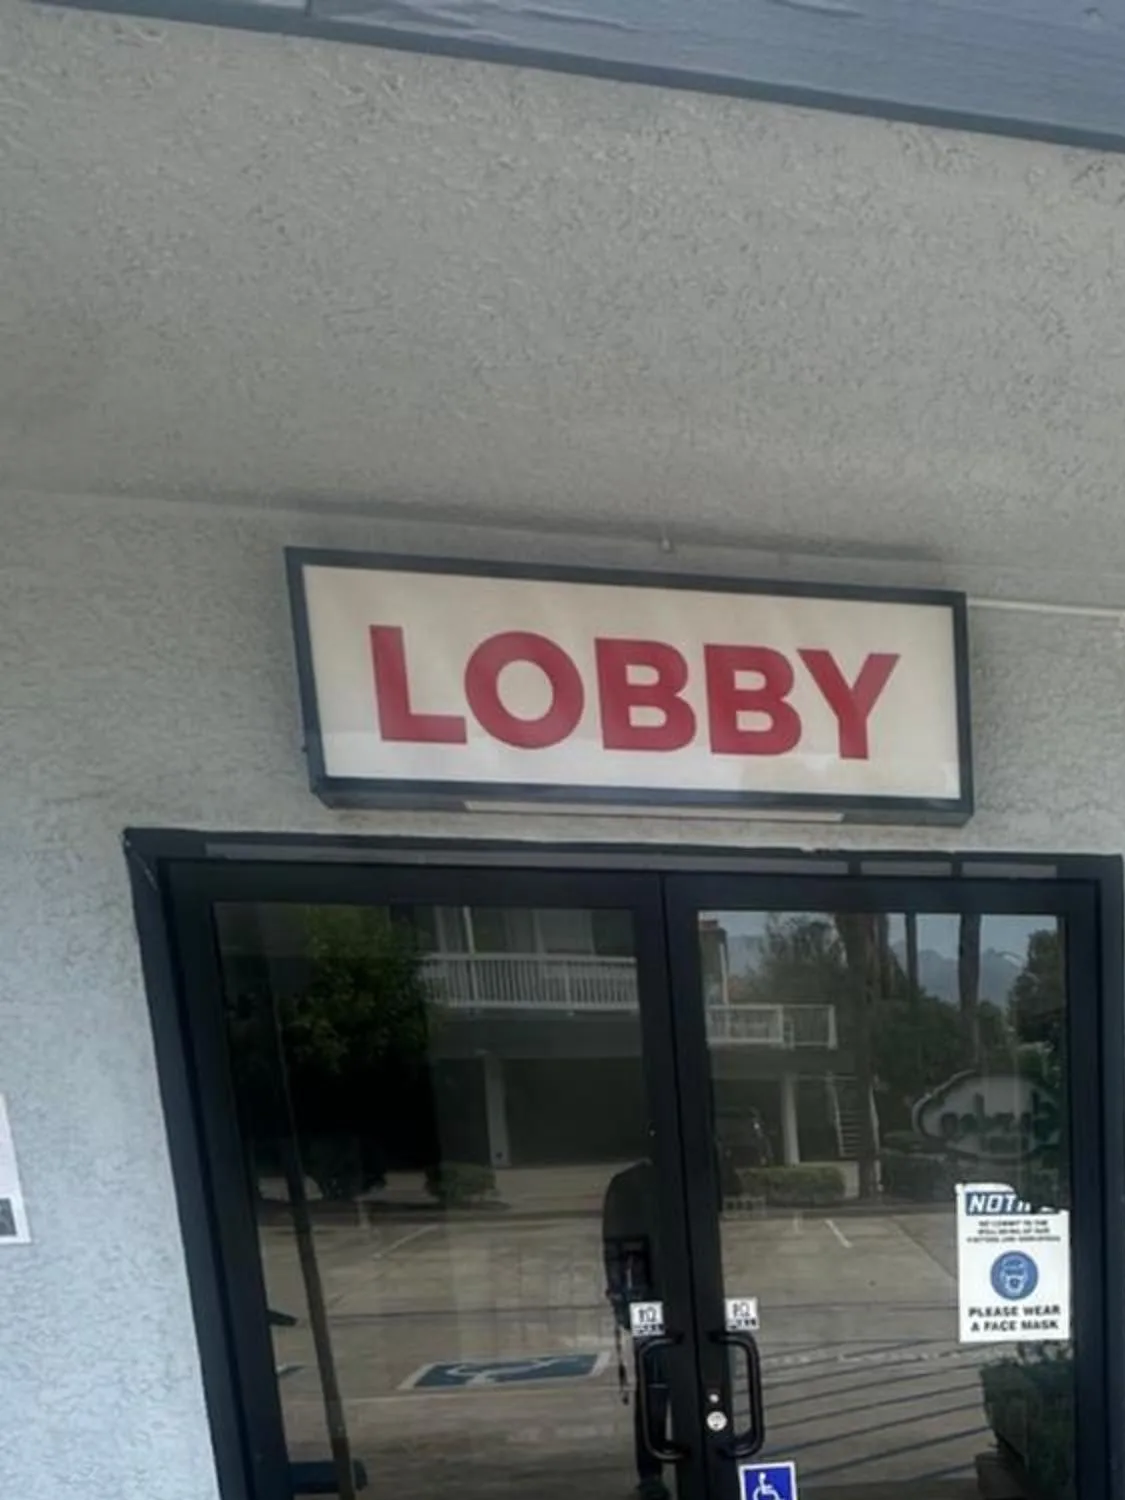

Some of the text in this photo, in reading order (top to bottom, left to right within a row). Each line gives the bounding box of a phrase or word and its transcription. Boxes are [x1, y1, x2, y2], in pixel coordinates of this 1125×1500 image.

[369, 624, 900, 761] LOBBY
[968, 1304, 1061, 1318] PLEASE WEAR
[970, 1318, 1059, 1332] A FACE MASK
